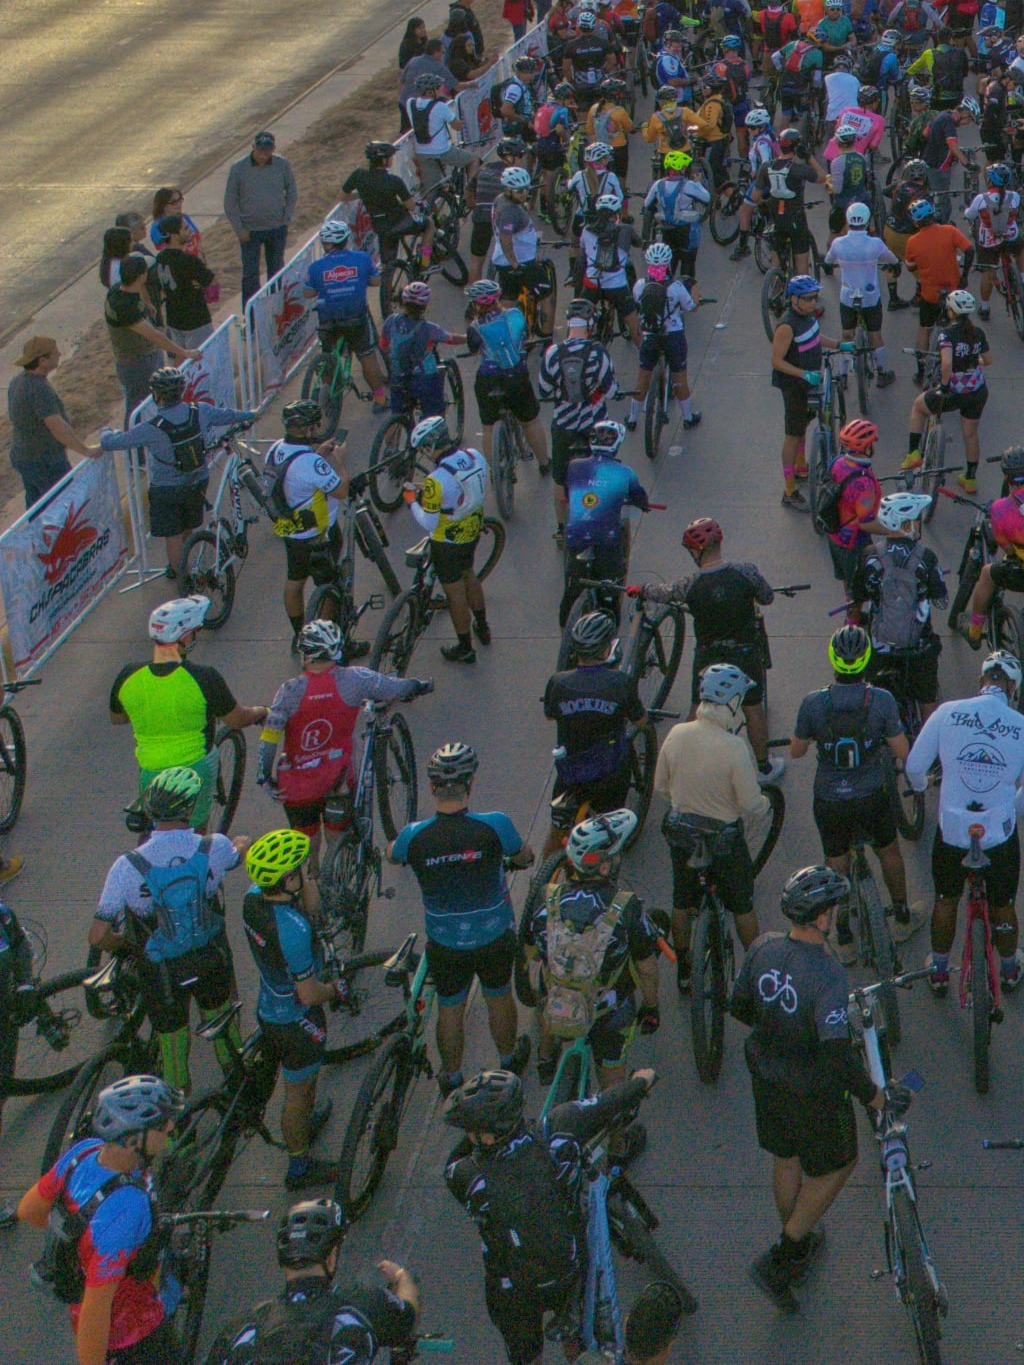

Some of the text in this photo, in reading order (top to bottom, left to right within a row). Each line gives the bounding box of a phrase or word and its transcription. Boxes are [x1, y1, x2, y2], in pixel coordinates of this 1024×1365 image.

[328, 269, 354, 280] Alpecin
[30, 527, 111, 624] CHUPACABRAS
[559, 698, 618, 715] ROCKIES
